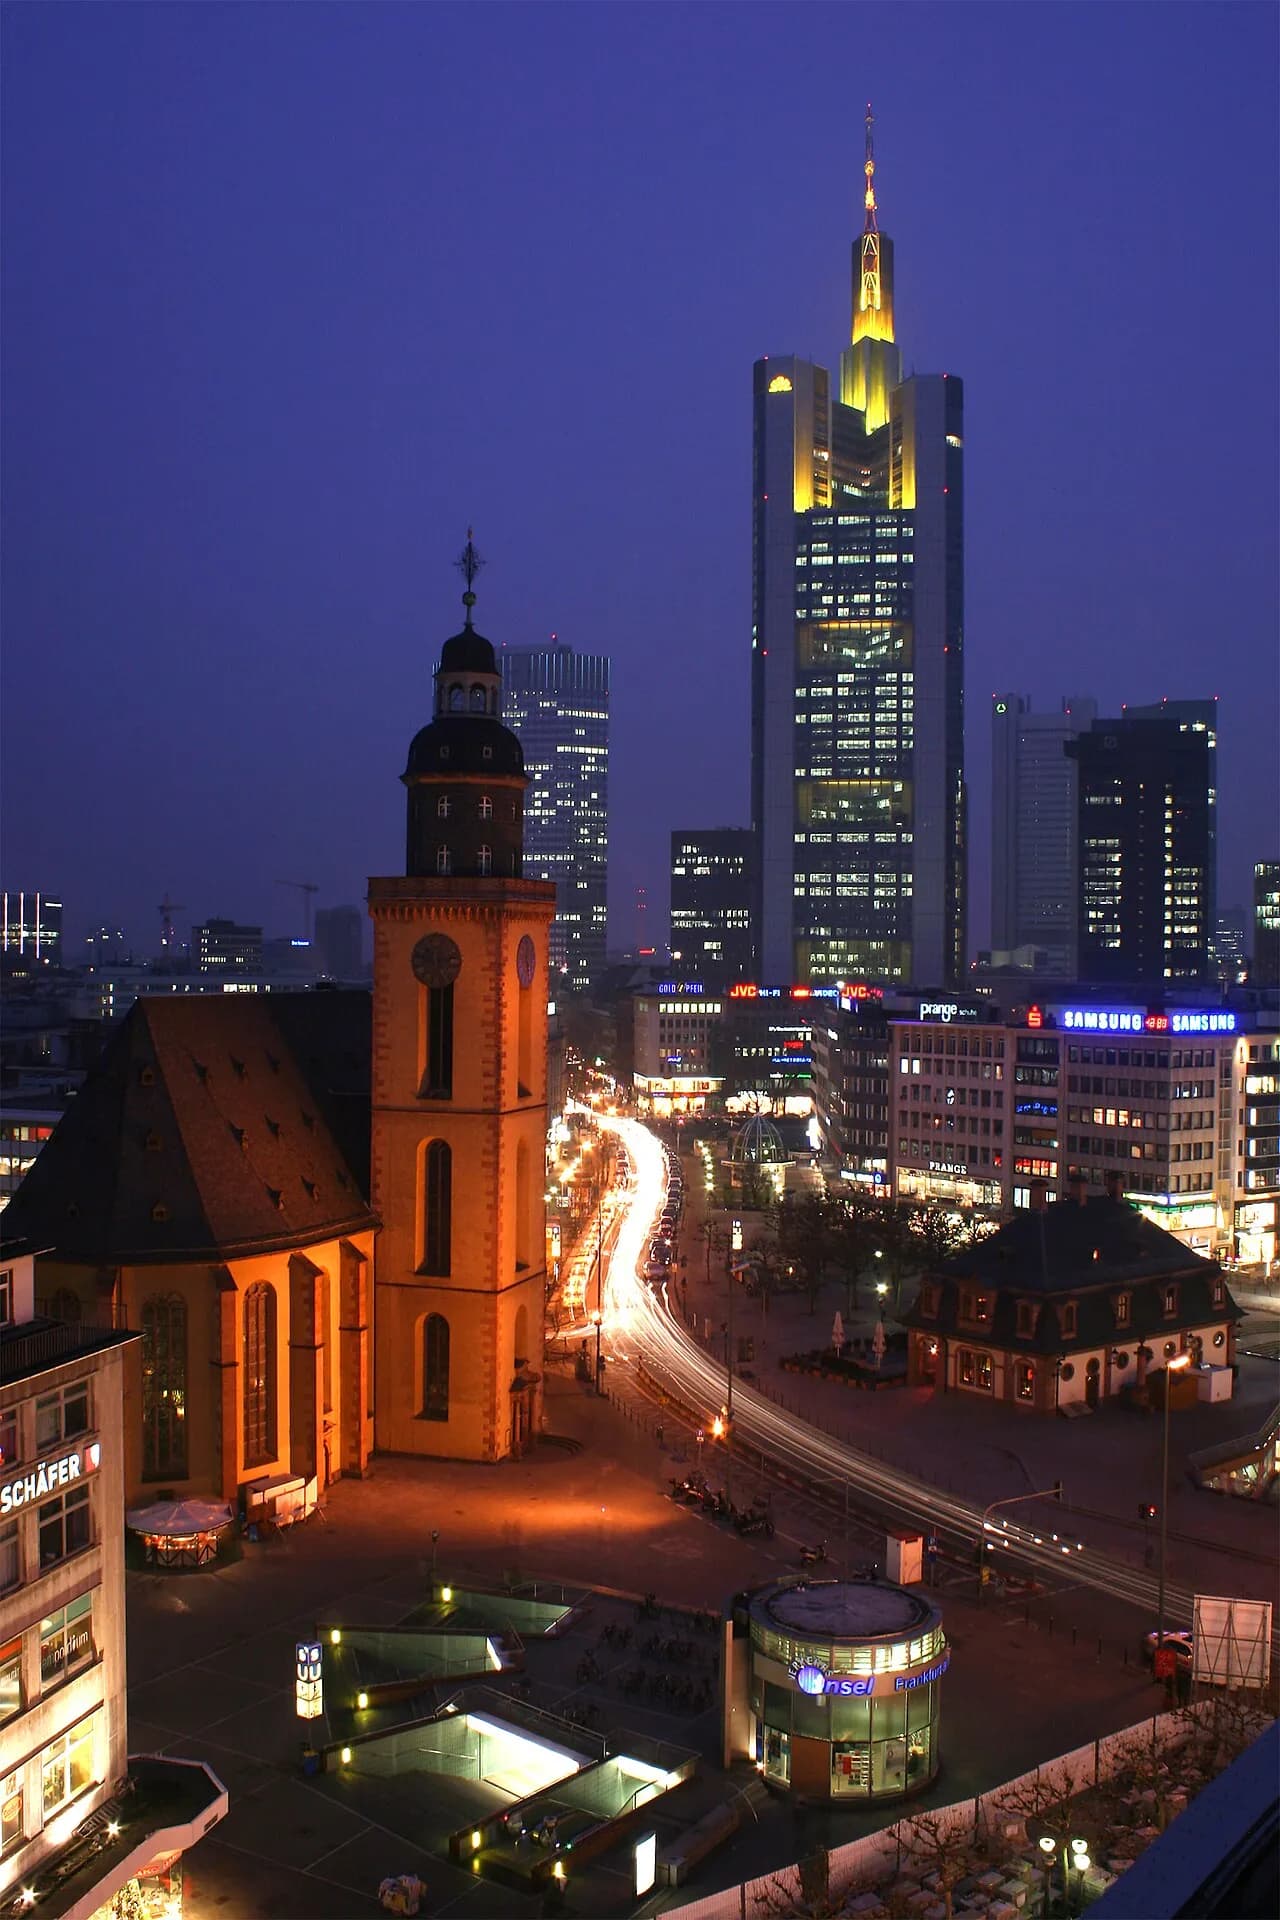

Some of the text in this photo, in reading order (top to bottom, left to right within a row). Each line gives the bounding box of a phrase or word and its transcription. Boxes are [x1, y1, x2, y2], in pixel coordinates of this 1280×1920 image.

[730, 984, 757, 997] JVC
[841, 986, 867, 998] JVC
[920, 1003, 958, 1022] prange
[1064, 1011, 1142, 1030] SAMSUNG
[1172, 1014, 1236, 1031] SAMSUNG
[929, 1161, 968, 1175] PRANGE
[0, 1453, 80, 1513] SCHÄFER
[894, 1664, 942, 1691] Frankfurt
